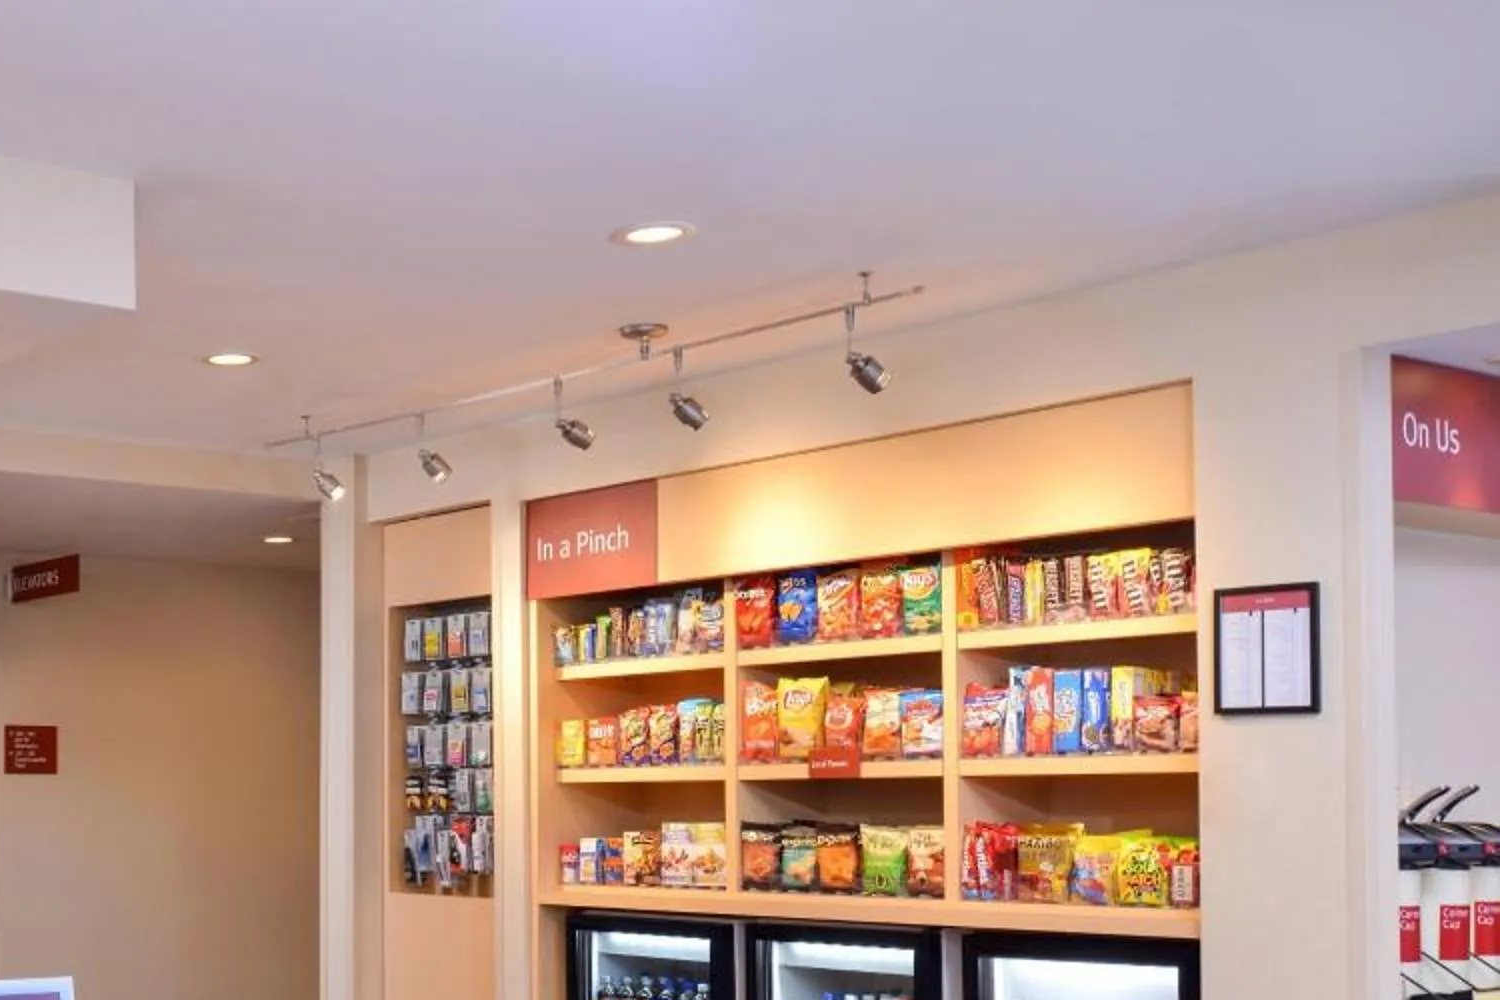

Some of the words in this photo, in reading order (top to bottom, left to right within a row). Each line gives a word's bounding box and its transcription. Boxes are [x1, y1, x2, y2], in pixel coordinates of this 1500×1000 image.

[1403, 411, 1429, 449] On
[1435, 417, 1460, 455] Us
[537, 537, 553, 561] In
[559, 539, 571, 559] a
[576, 523, 629, 556] Pinch
